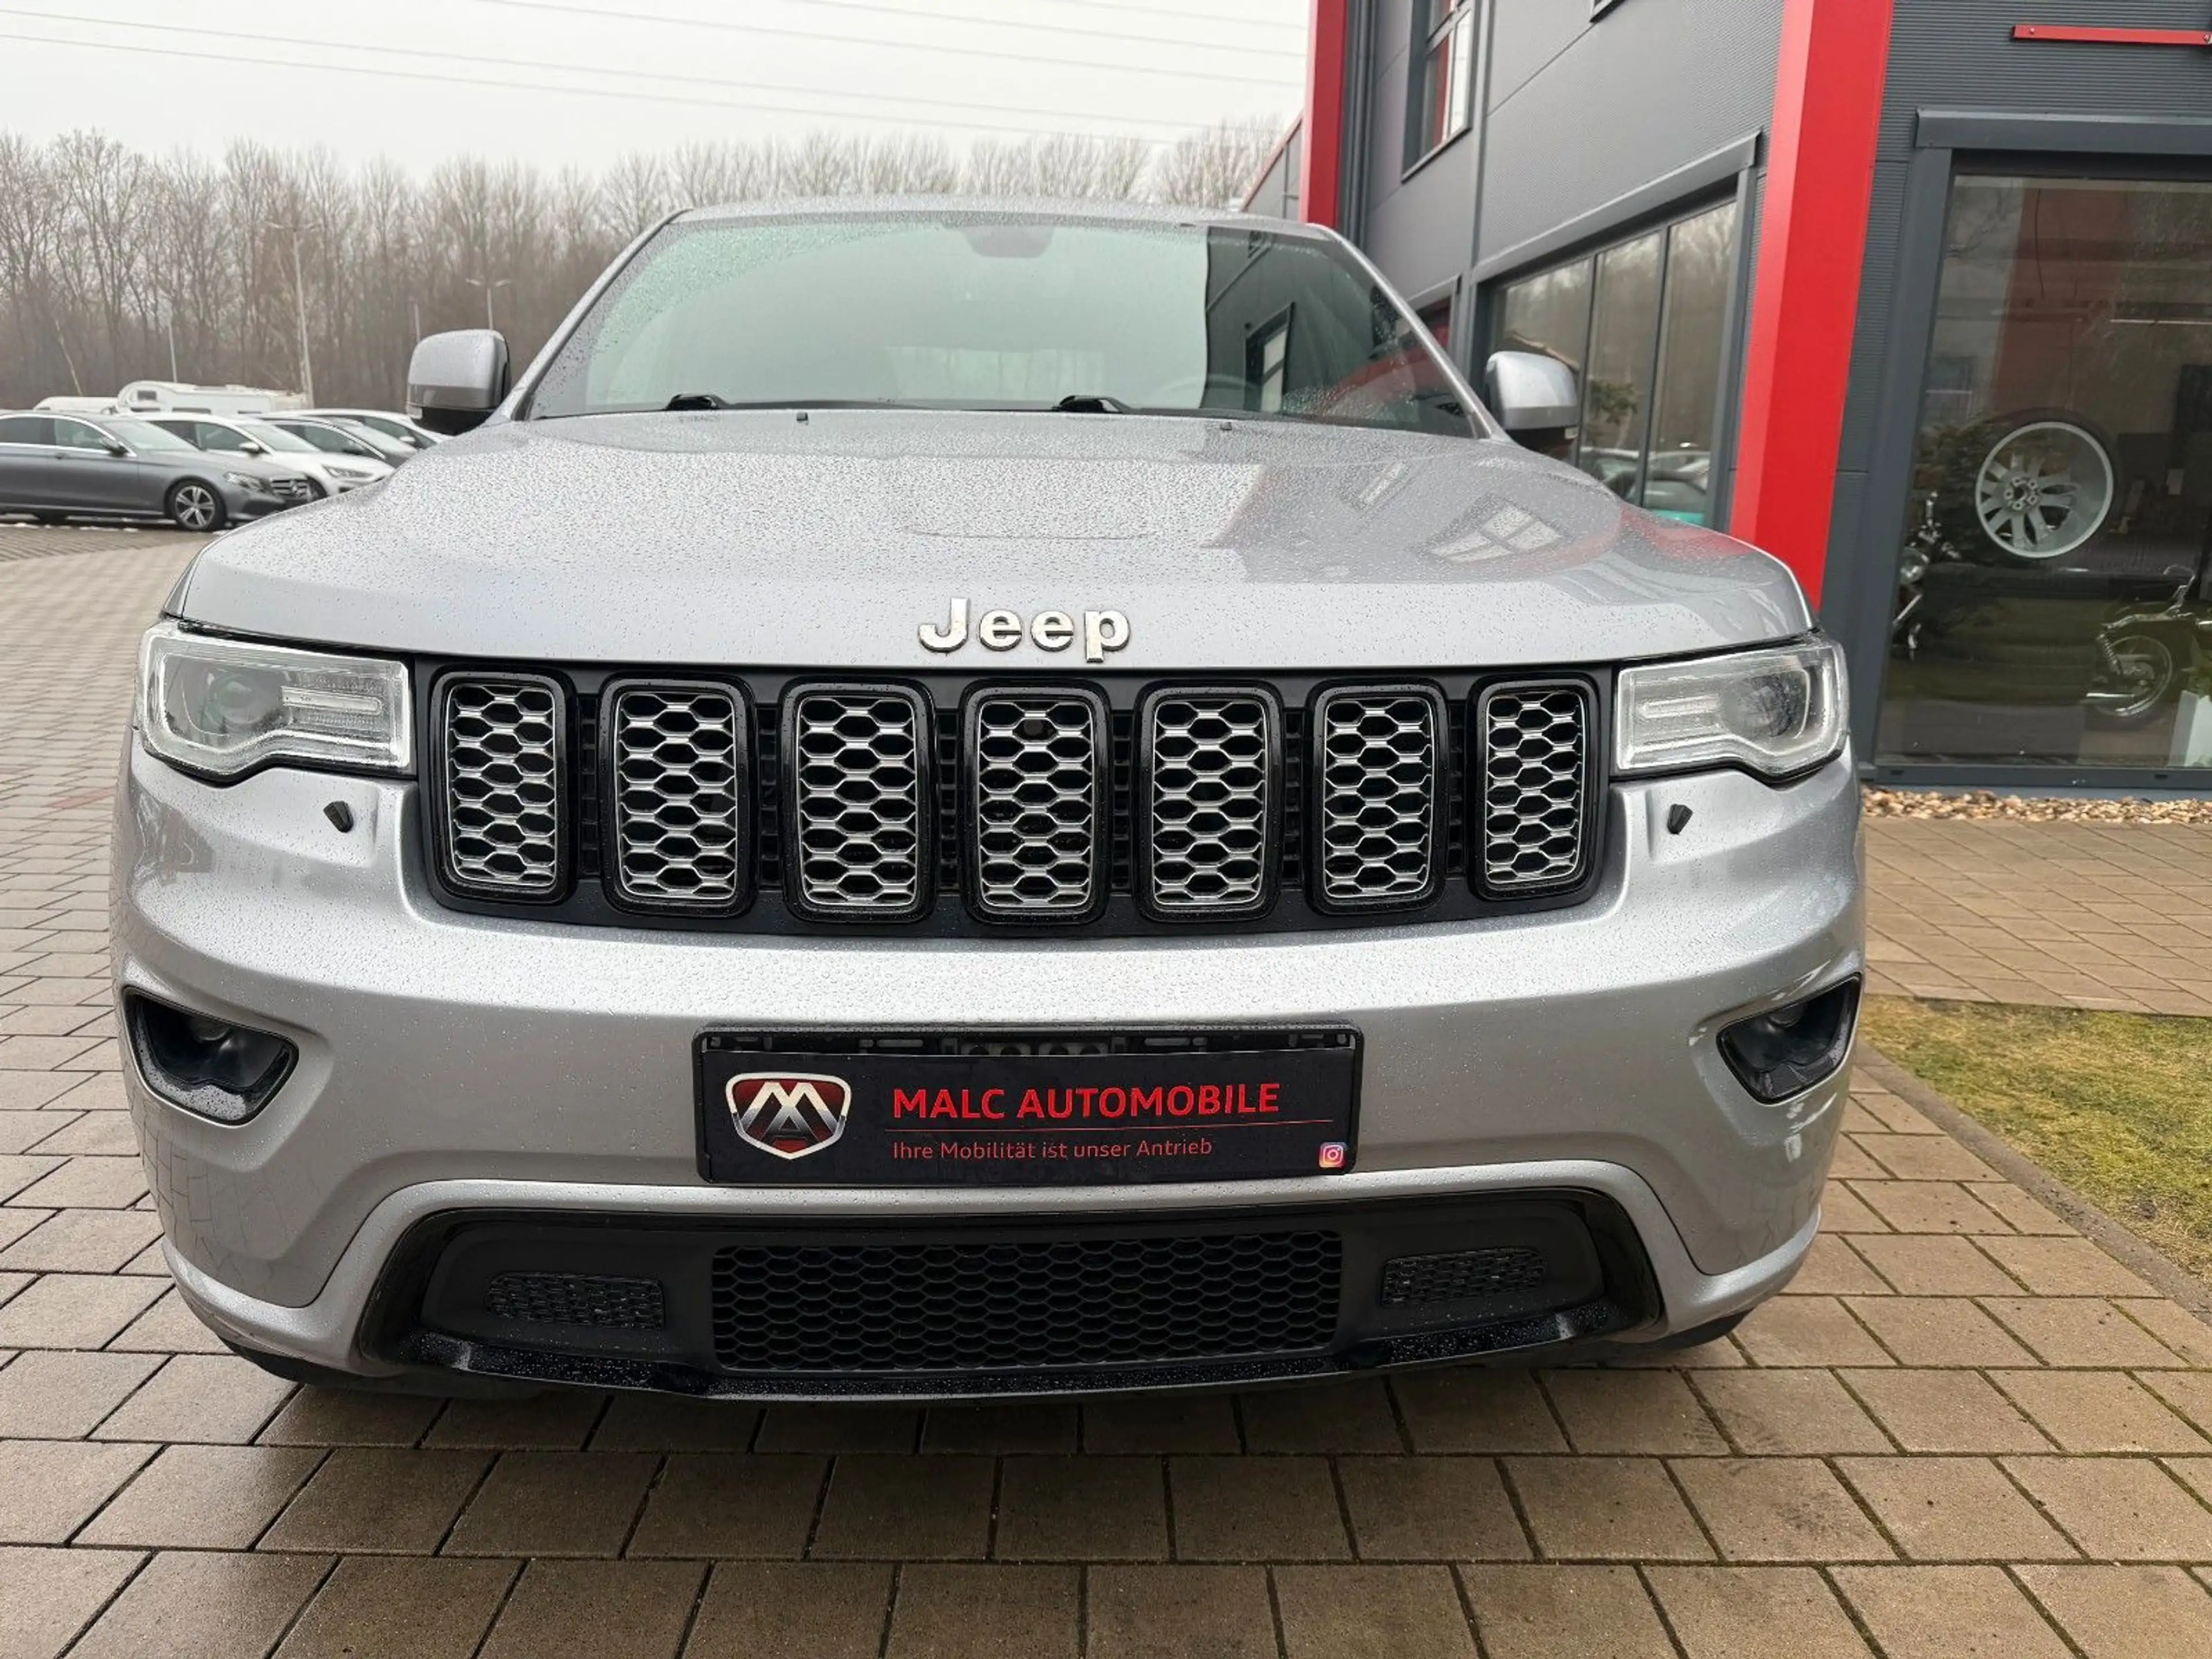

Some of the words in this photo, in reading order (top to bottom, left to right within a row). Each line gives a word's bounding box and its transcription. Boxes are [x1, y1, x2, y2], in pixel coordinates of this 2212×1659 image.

[918, 597, 1131, 663] Jeep
[893, 1088, 1005, 1119] MALC
[1017, 1083, 1280, 1119] AUTOMOBILE
[893, 1141, 933, 1159] Ihre
[940, 1141, 1036, 1160] Mobilität
[1041, 1141, 1067, 1158] ist
[1074, 1143, 1130, 1157] unser
[1136, 1138, 1213, 1156] Antrieb
